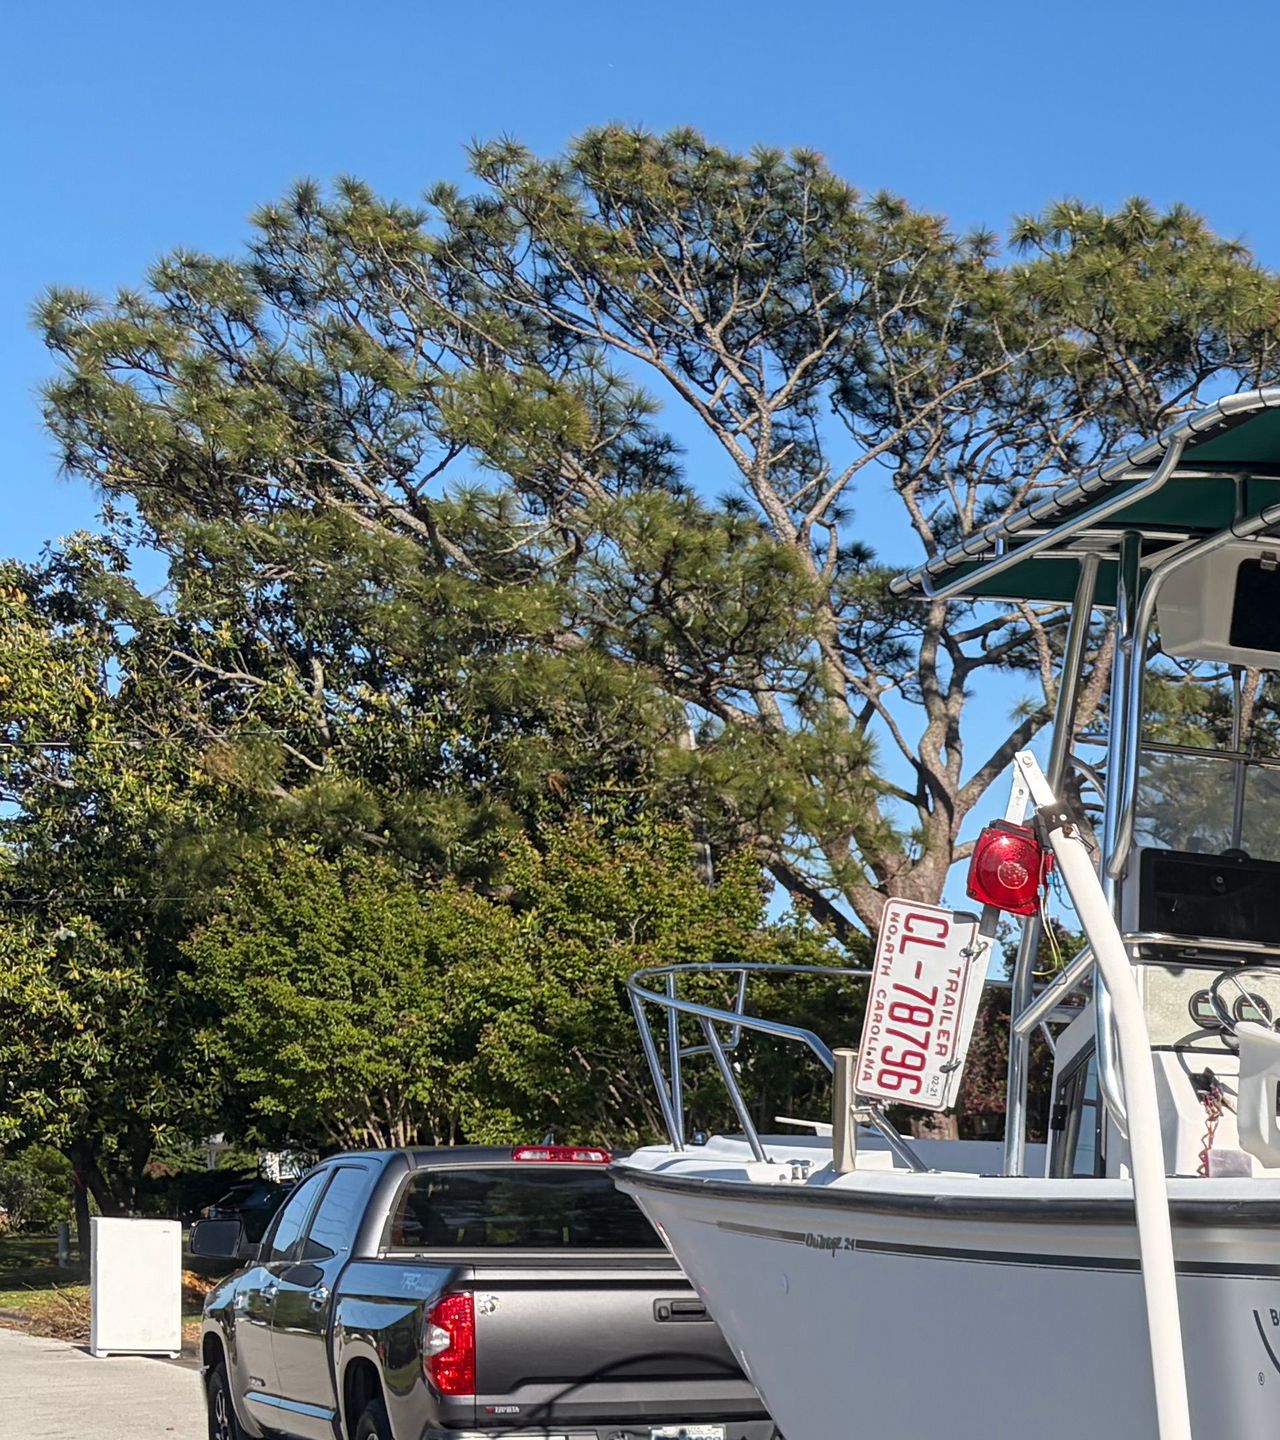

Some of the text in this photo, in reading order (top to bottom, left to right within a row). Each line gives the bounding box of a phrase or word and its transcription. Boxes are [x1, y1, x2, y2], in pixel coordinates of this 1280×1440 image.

[862, 989, 887, 1082] CAROLINA
[876, 912, 950, 1096] CL-78796
[934, 966, 961, 1057] TRAILER
